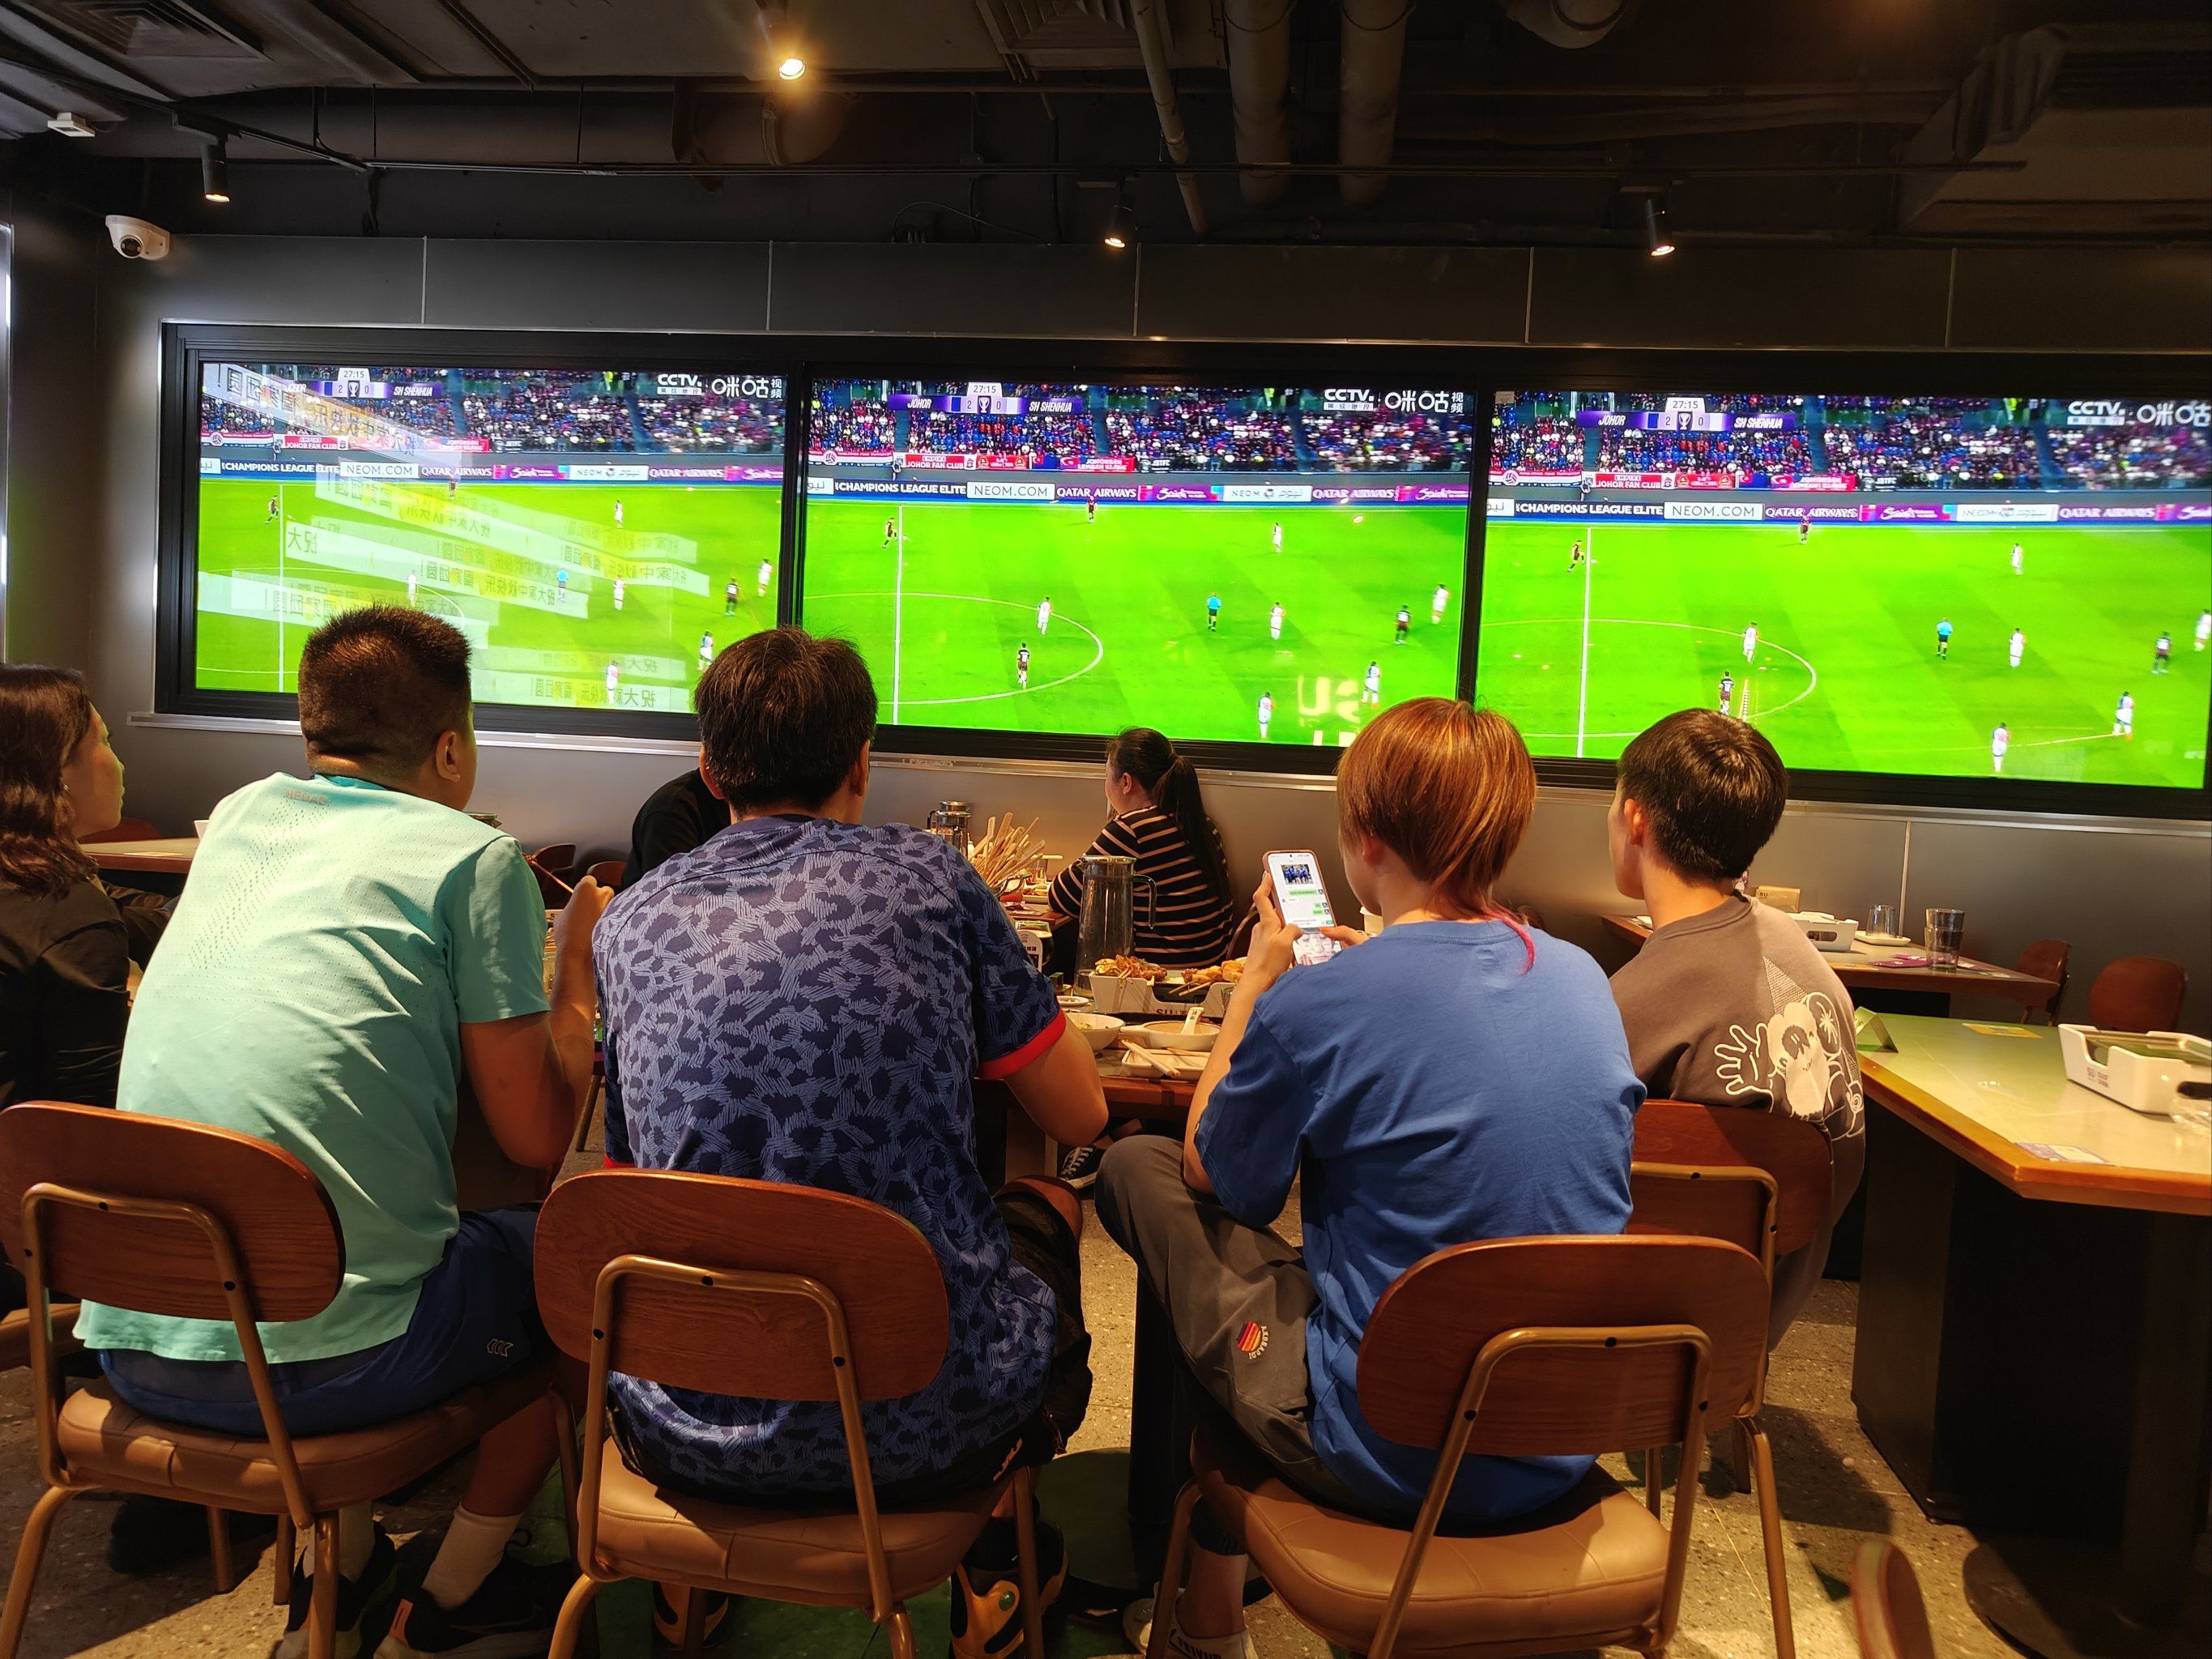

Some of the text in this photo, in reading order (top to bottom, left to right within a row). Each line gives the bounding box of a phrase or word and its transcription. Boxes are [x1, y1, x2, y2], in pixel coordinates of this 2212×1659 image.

[343, 370, 364, 379] 27:15
[338, 385, 343, 394] 2
[364, 386, 369, 394] 0
[394, 386, 403, 396] SH
[404, 386, 433, 397] SHENHUA
[711, 377, 782, 399] 咪咕 视频
[973, 385, 996, 394] 27:15
[907, 399, 1072, 412] JOHOR 2 0 SH SHENHUA
[1384, 390, 1464, 414] 咪咕 视频
[1673, 400, 1698, 409] 27:15
[1598, 415, 1626, 426] JOHOR
[1665, 416, 1671, 426] 2
[1698, 417, 1703, 426] 0
[224, 461, 280, 472] CHAMPIONS
[280, 463, 315, 473] LEAGUE
[346, 465, 413, 475] NEOM.COM
[421, 467, 492, 477] QATAR AIRWAYS
[839, 482, 967, 495] CHAMPIONS LEAGUE ELITE
[1625, 481, 1640, 489] FAN
[974, 485, 1048, 497] NEOM.COM
[1056, 487, 1137, 498] QATAR AIRWAYS
[1522, 503, 1663, 515] CHAMPIONS LEAGUE ELITE
[1672, 505, 1754, 517] NEOM.COM
[1765, 507, 1858, 518] QATAR AIRWAYS
